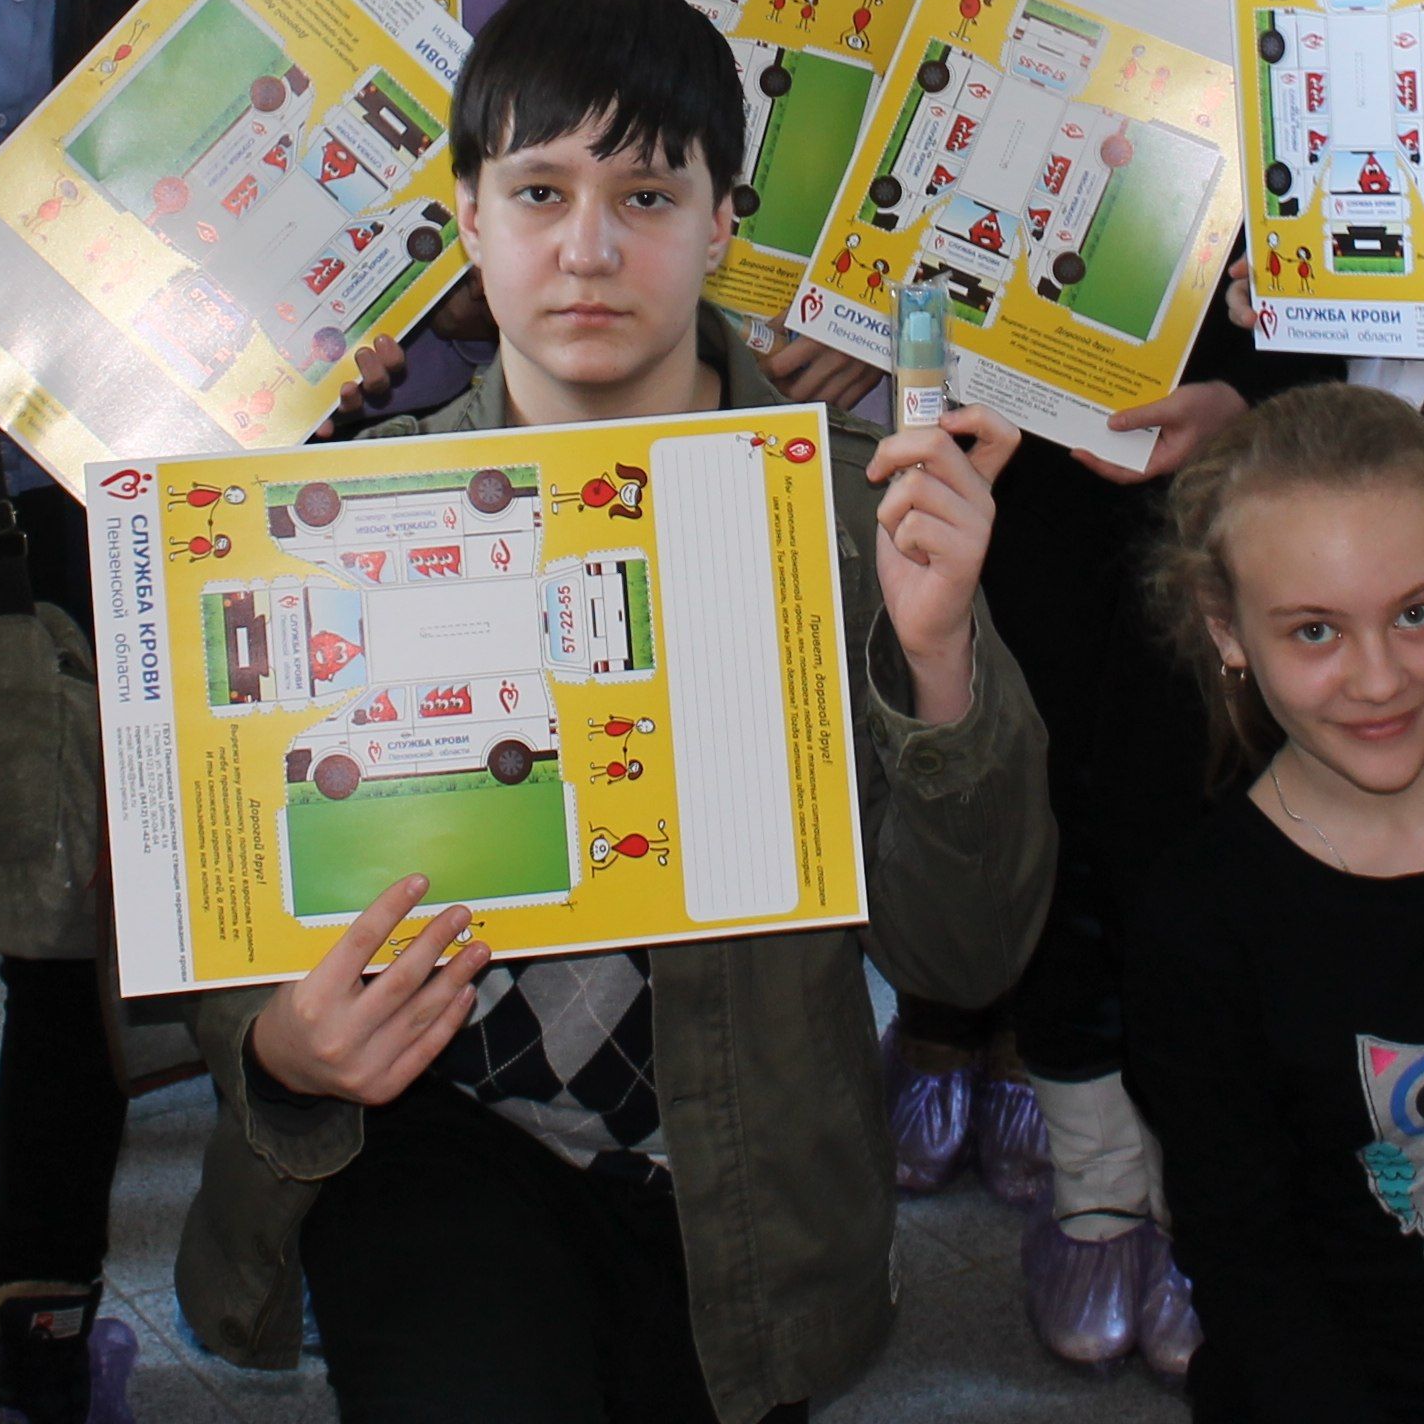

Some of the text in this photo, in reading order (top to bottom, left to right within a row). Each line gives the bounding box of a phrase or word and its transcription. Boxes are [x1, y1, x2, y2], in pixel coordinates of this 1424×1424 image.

[414, 37, 463, 85] РОВИ
[428, 22, 470, 63] бласти
[832, 303, 896, 339] СЛУЖБ
[1284, 307, 1401, 324] СЛУЖБА КРОВИ
[1286, 325, 1403, 343] Пензенской области
[105, 516, 134, 703] Пензенской области
[130, 513, 160, 701] СЛУЖБА КРОВИ
[556, 585, 575, 654] 57-22-55
[807, 613, 833, 766] Привет, дорогой друг!
[386, 733, 470, 751] СЛУЖБА КРОВИ
[247, 796, 267, 886] Дорогой друг!
